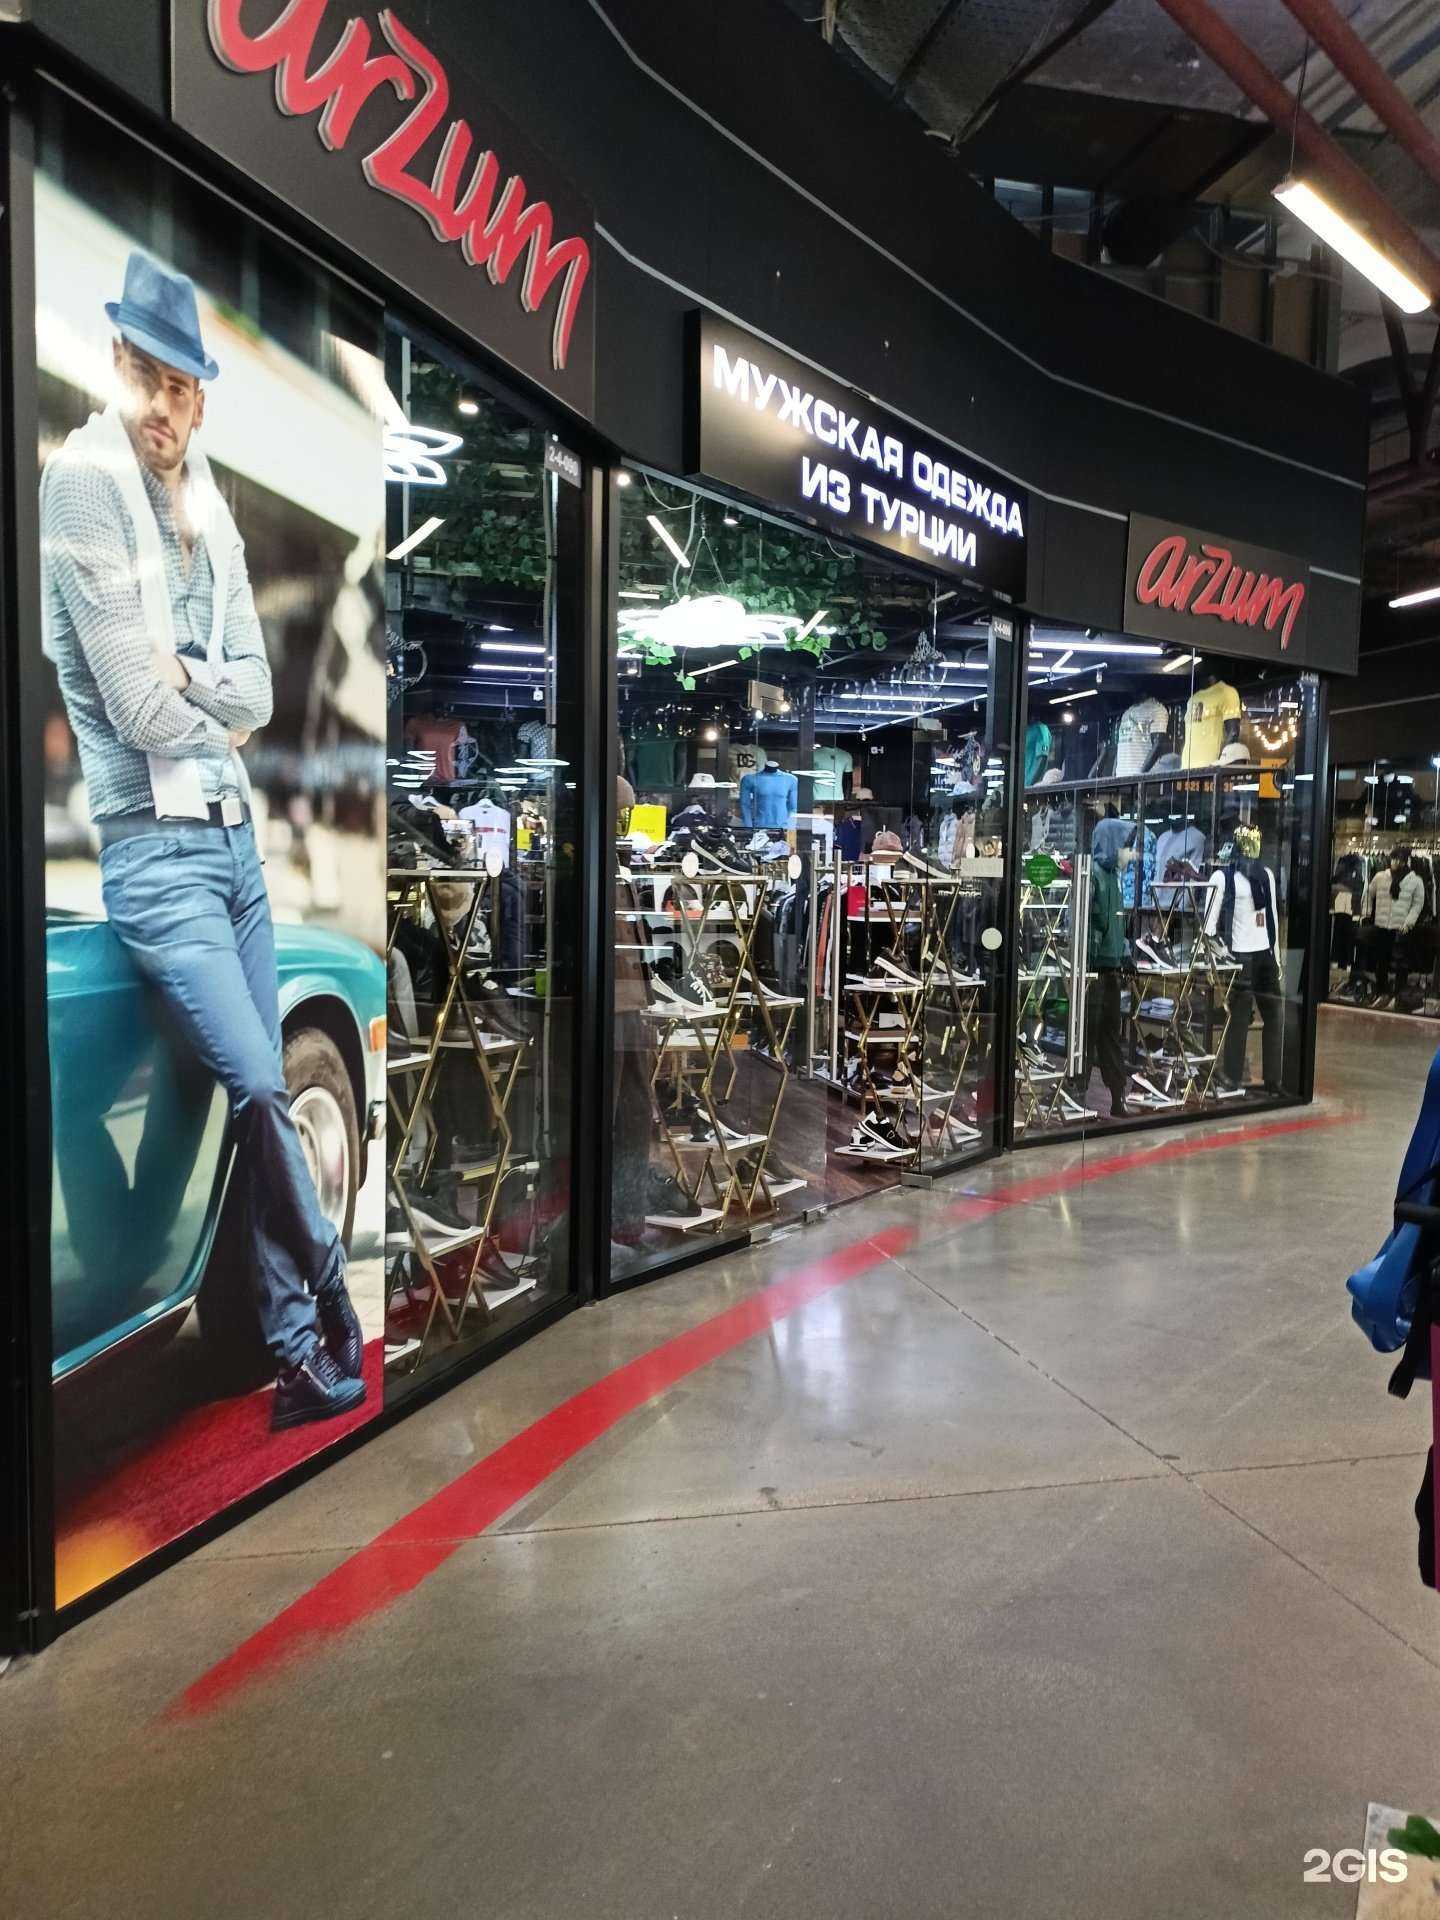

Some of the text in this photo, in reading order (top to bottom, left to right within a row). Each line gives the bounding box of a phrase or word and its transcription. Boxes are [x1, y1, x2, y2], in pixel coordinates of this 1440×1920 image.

[713, 344, 1025, 538] МУЖСКАЯ ОДЕЖДА
[802, 457, 978, 567] ИЗ ТУРЦИИ
